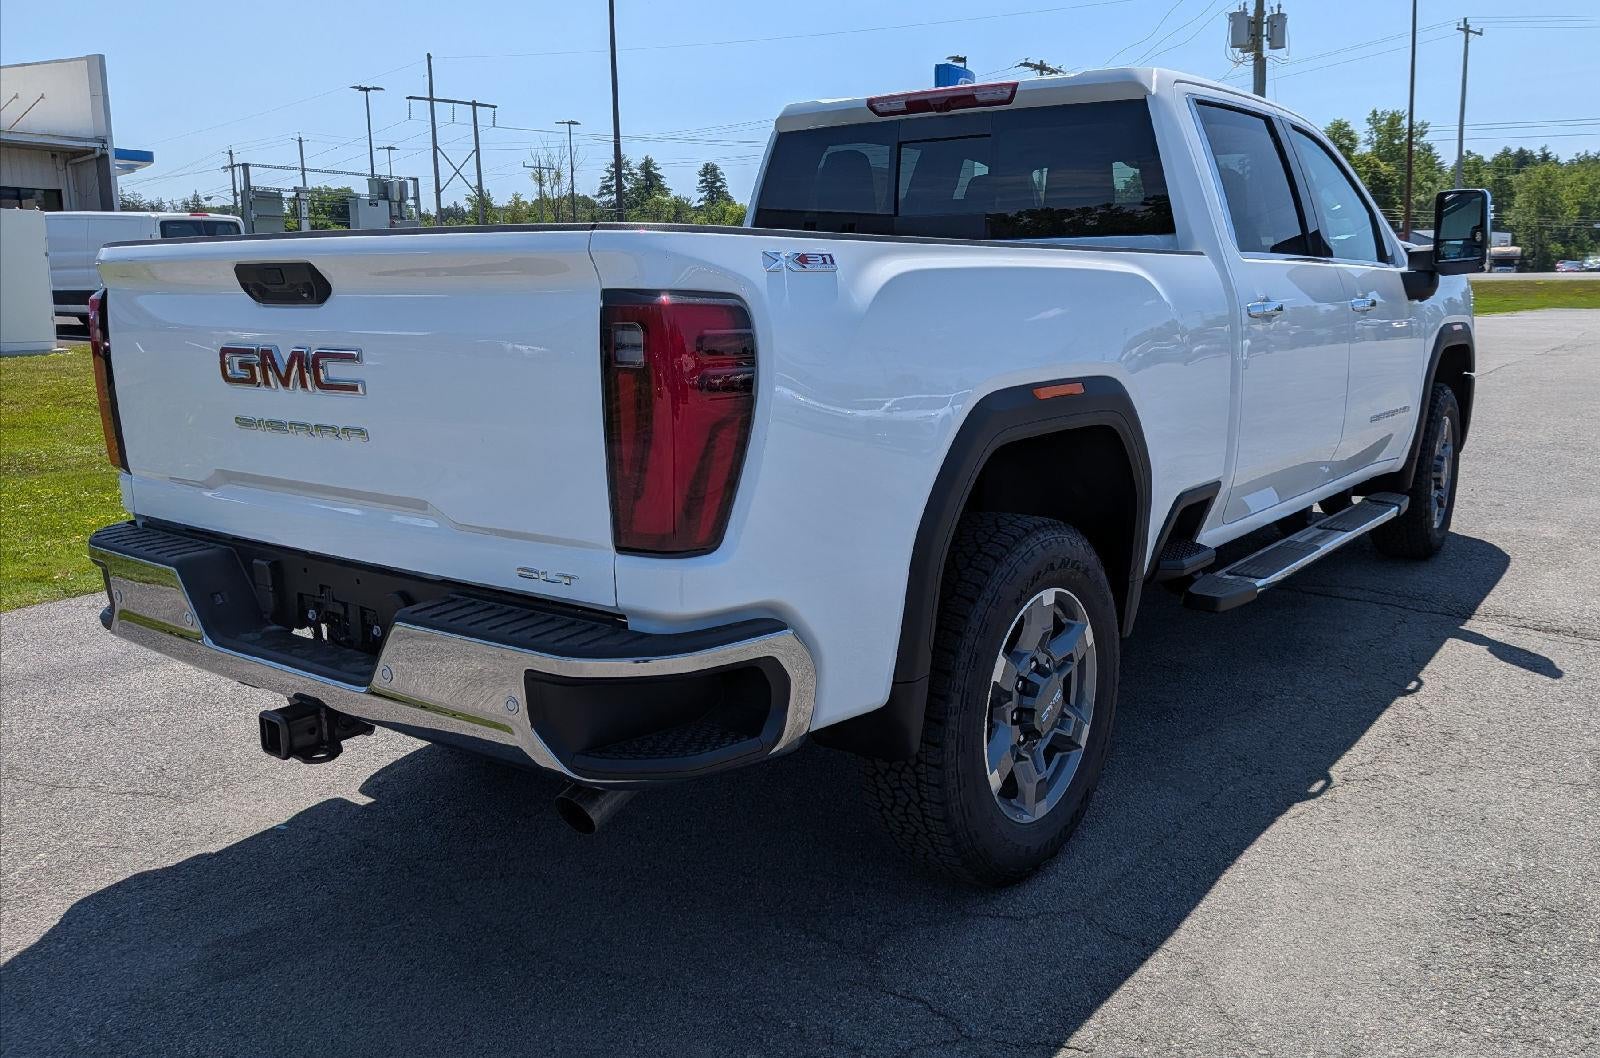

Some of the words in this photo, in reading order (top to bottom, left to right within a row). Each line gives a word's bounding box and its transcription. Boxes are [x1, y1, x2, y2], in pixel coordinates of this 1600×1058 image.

[219, 343, 366, 397] GMC
[234, 415, 370, 443] SIERRA
[516, 566, 580, 585] SLT
